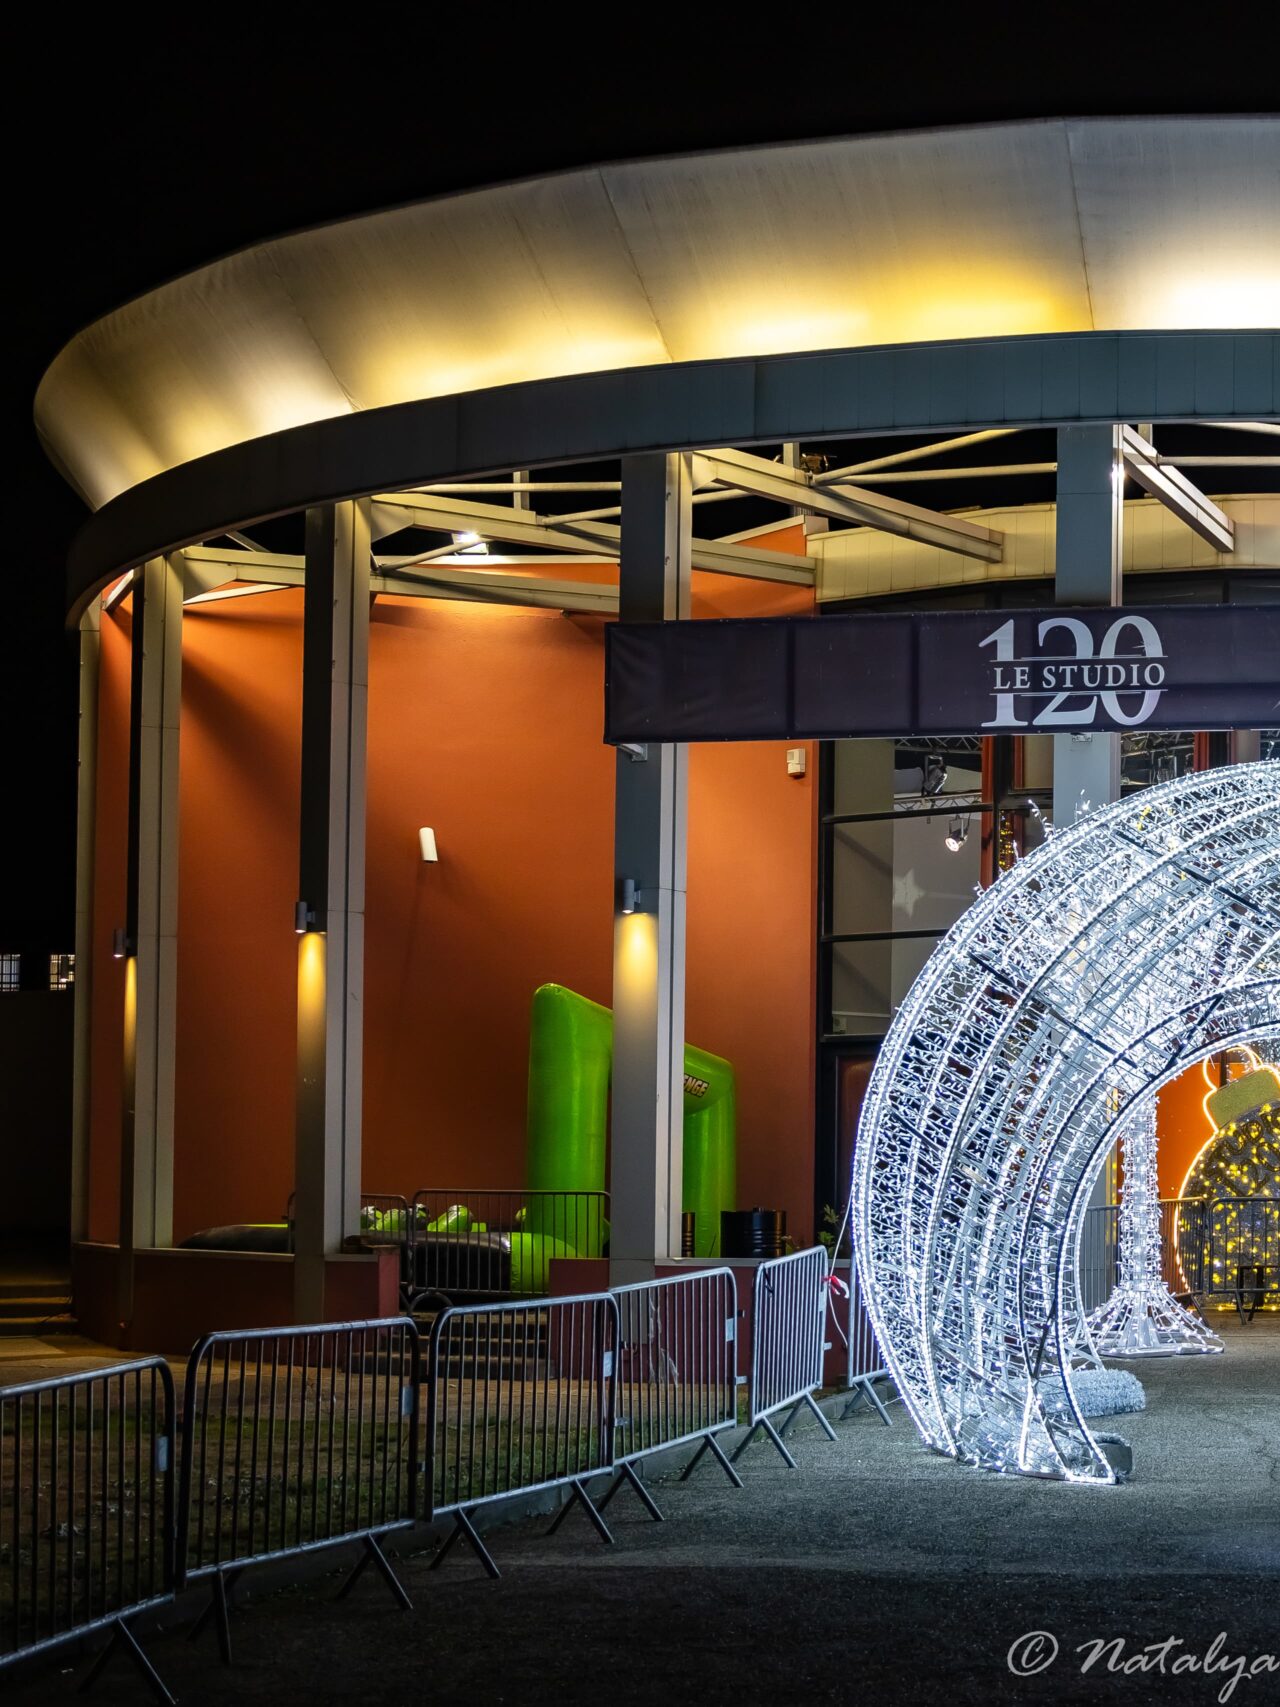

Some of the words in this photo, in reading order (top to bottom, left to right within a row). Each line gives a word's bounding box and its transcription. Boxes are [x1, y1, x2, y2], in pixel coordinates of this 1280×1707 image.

[978, 615, 1164, 727] 120
[993, 667, 1031, 690] LE
[1042, 663, 1165, 689] STUDIO
